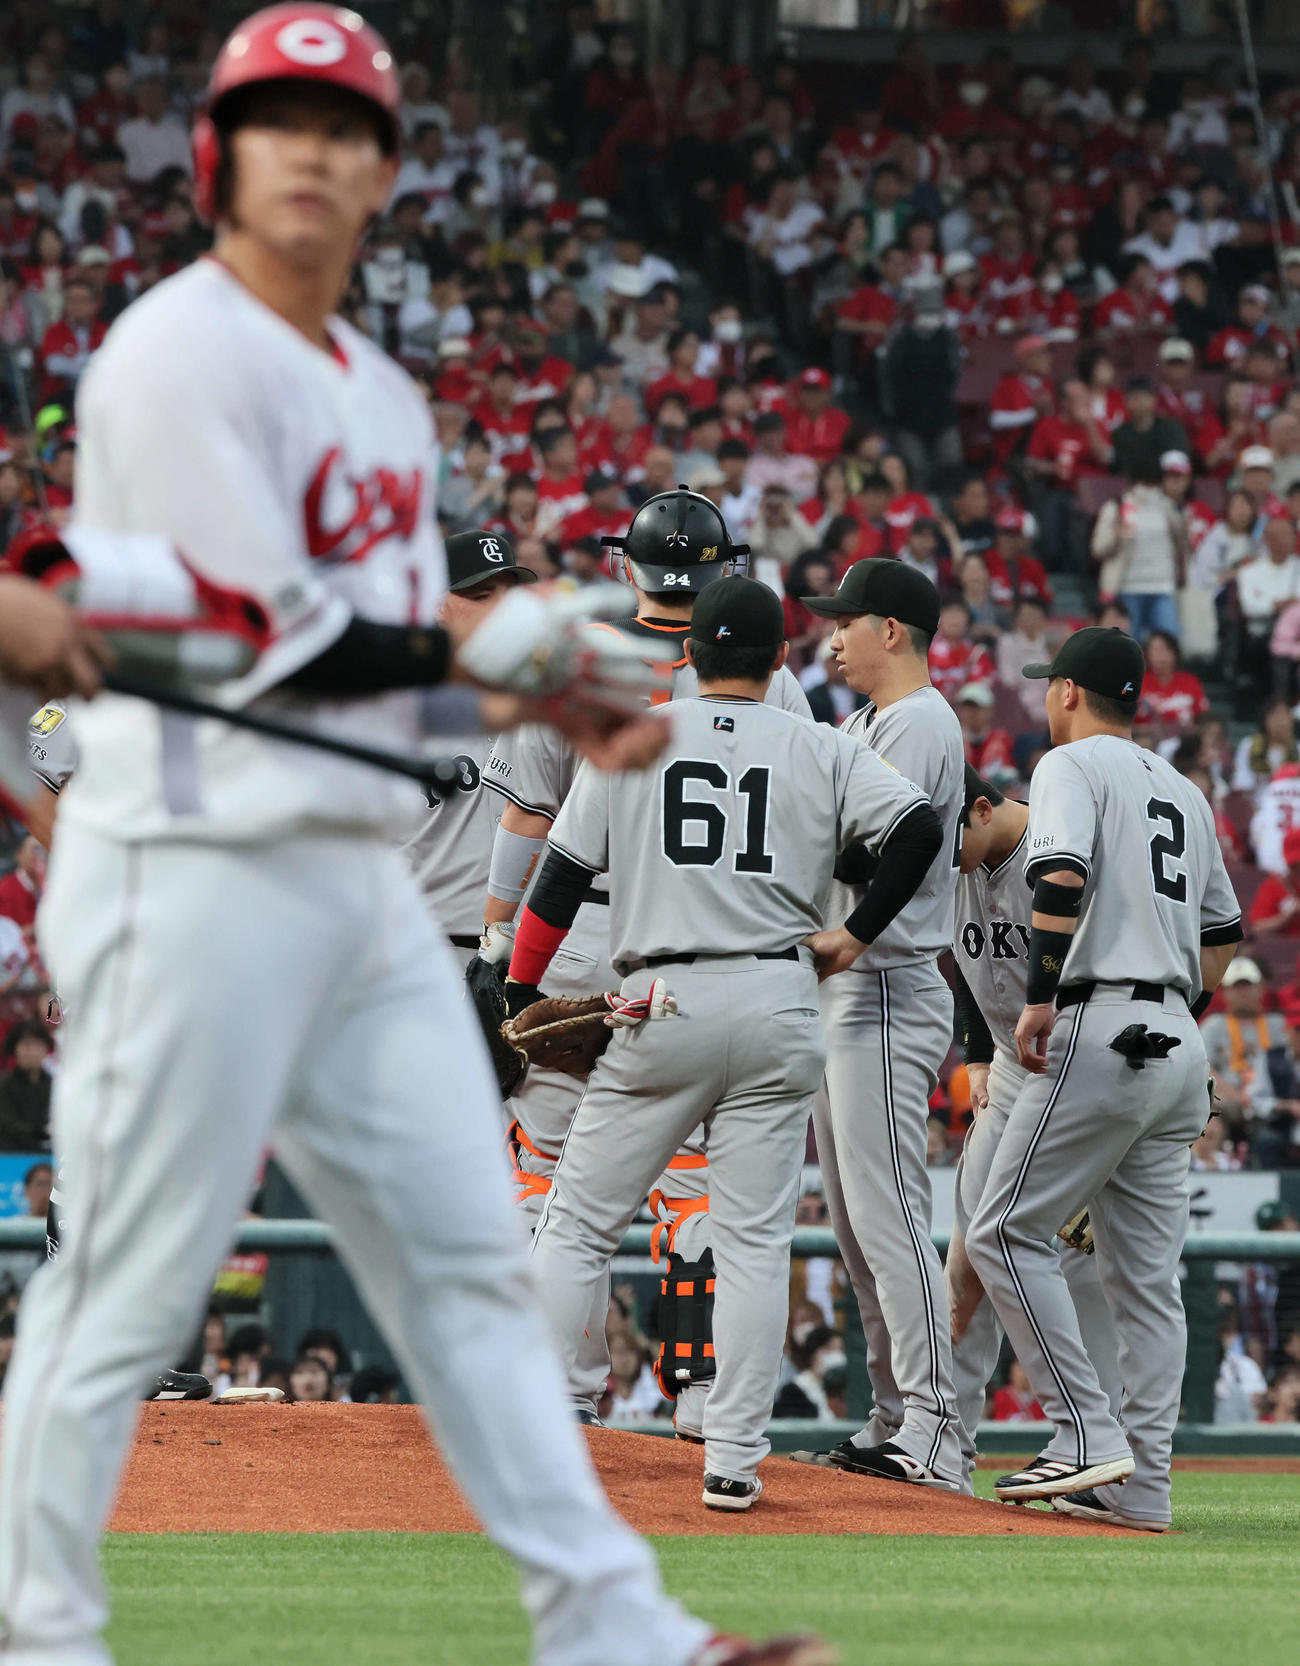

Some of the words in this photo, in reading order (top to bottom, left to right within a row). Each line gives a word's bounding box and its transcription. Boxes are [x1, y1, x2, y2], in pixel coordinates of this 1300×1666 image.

[663, 573, 690, 587] 24
[661, 757, 776, 877] 61
[1146, 794, 1188, 904] 2
[721, 1480, 733, 1489] 61
